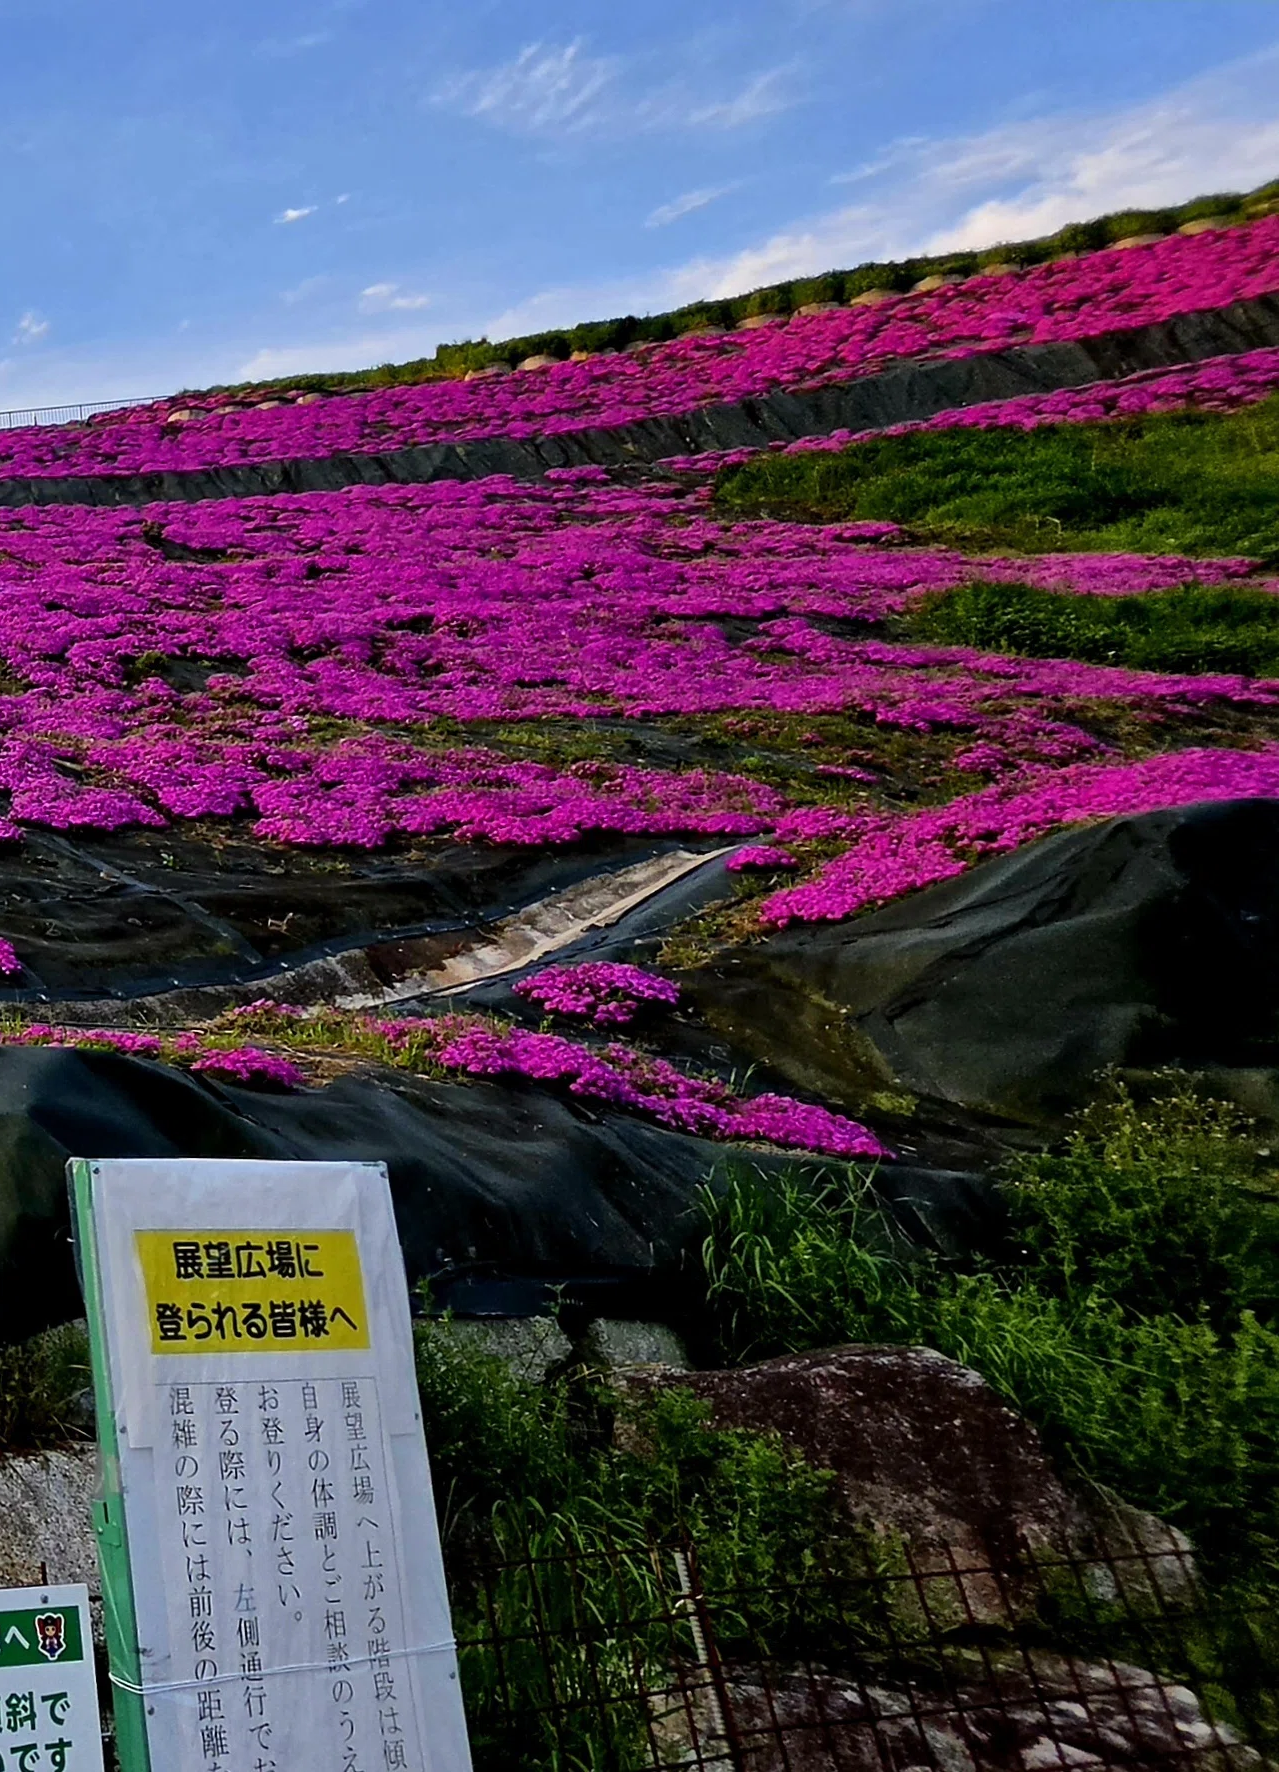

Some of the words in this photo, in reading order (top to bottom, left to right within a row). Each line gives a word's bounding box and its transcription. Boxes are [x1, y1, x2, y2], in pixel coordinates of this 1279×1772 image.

[172, 1240, 324, 1280] 展望広場に
[155, 1301, 358, 1342] 登られる皆様へ
[257, 1384, 303, 1623] お登りください。
